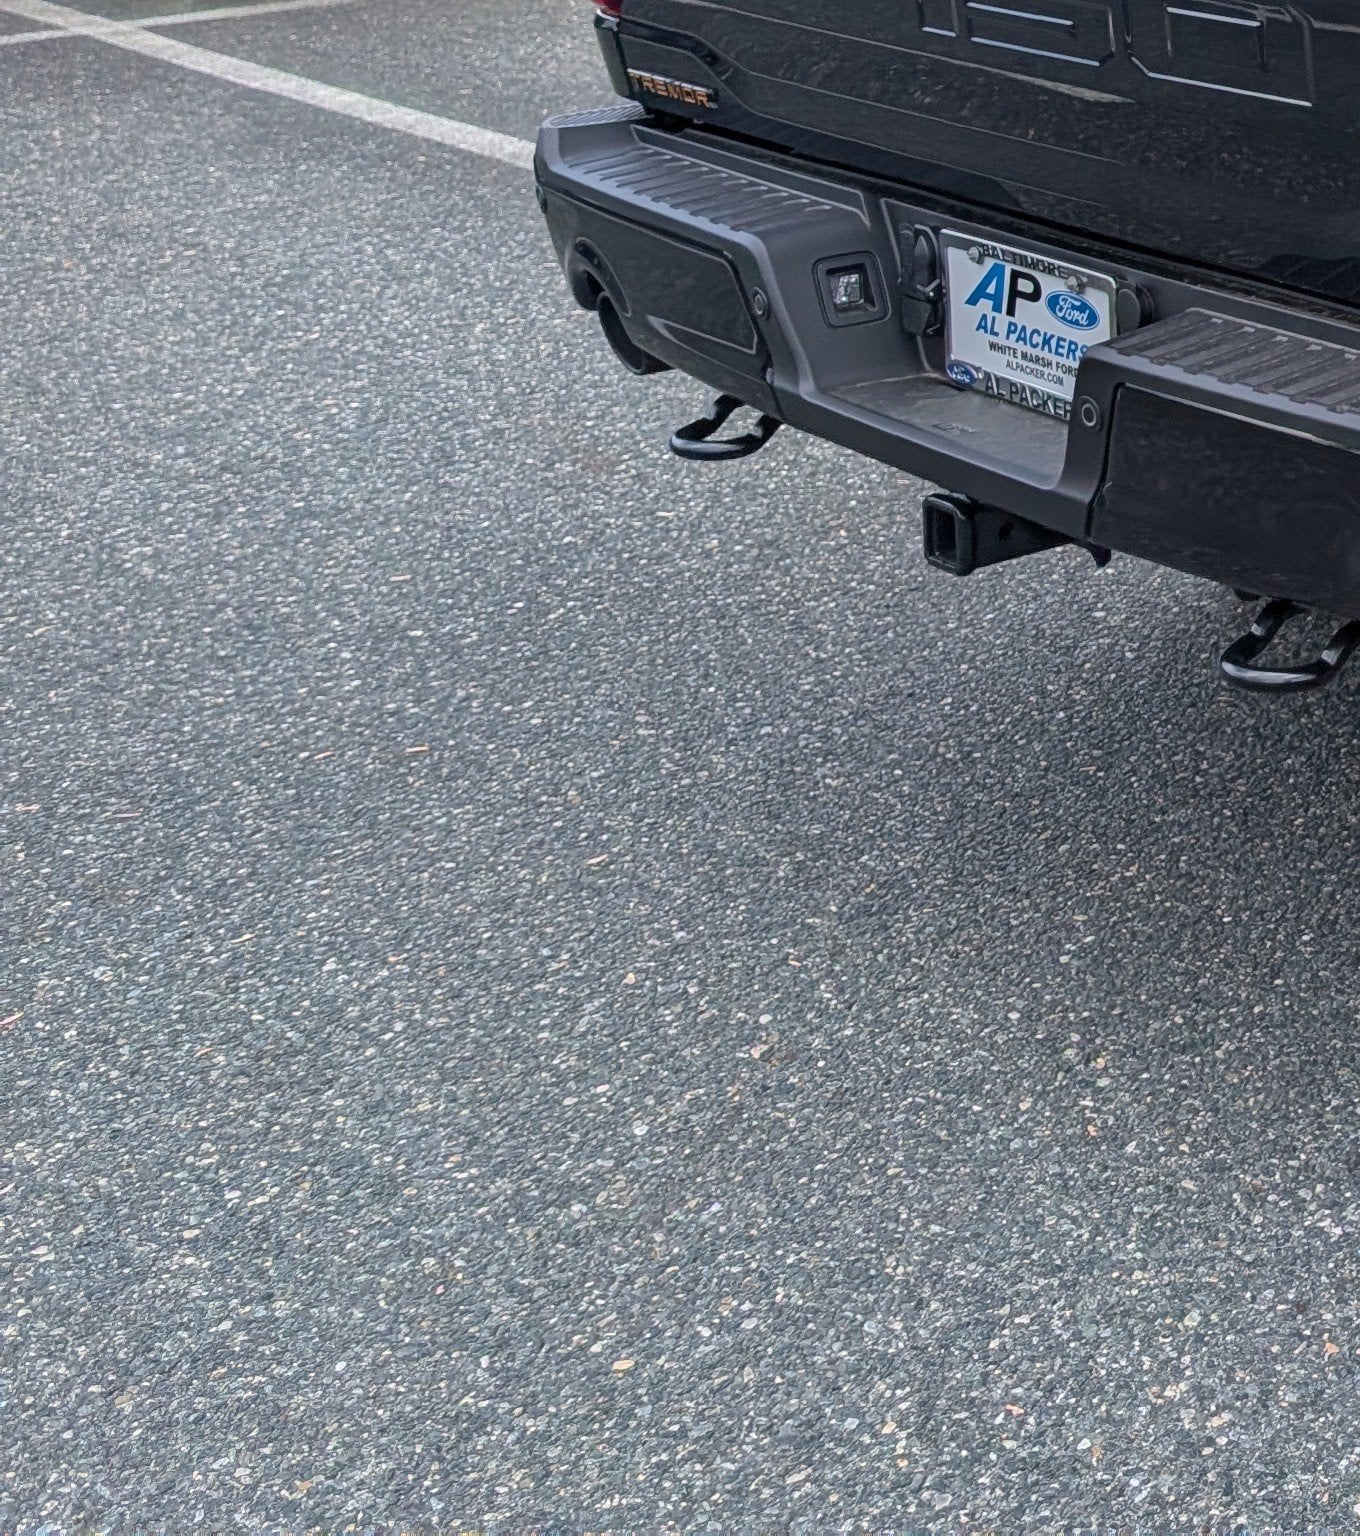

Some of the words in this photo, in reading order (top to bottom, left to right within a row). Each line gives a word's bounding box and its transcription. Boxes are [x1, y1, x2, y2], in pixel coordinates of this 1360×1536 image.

[628, 69, 716, 108] TREMOR
[964, 262, 1042, 318] AP
[975, 313, 1000, 337] AL
[1055, 295, 1091, 326] Ford
[988, 340, 1019, 360] WHITE
[1021, 350, 1053, 371] MARSH
[984, 373, 1005, 398] AL
[1005, 359, 1065, 387] ALPACKER.COM
